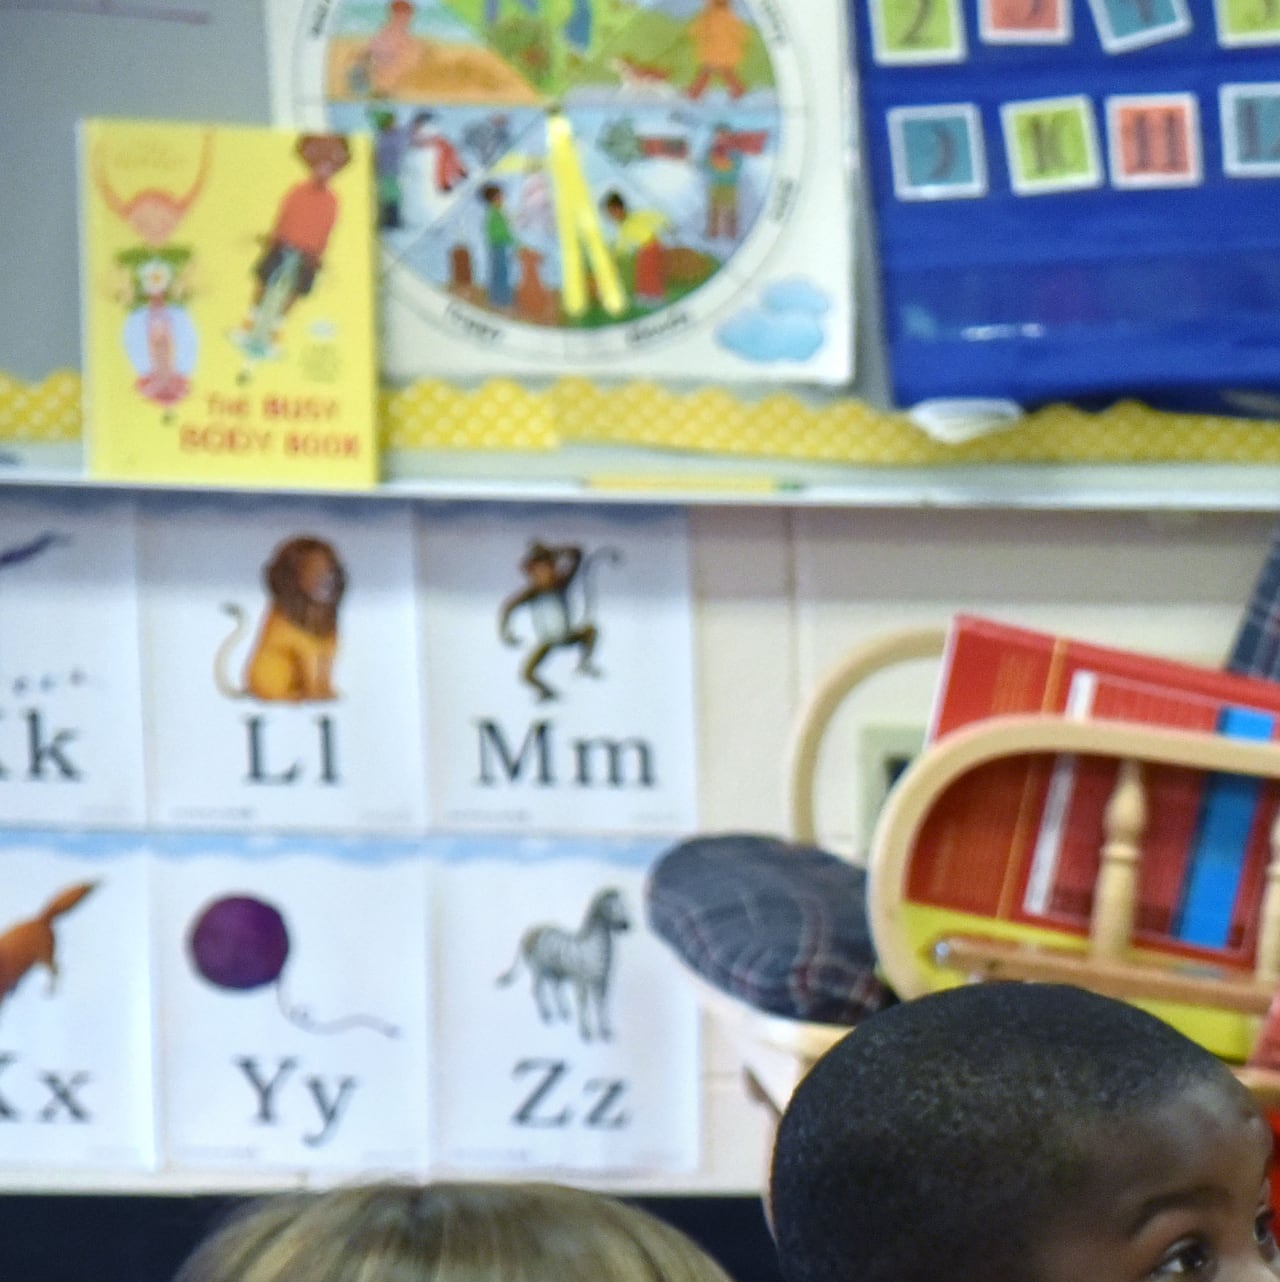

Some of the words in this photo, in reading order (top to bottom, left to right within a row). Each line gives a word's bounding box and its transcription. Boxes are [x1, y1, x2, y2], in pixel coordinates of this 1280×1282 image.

[1133, 111, 1186, 172] 11
[262, 394, 339, 421] BUSY
[179, 425, 272, 454] BODY
[283, 432, 360, 458] BOOK
